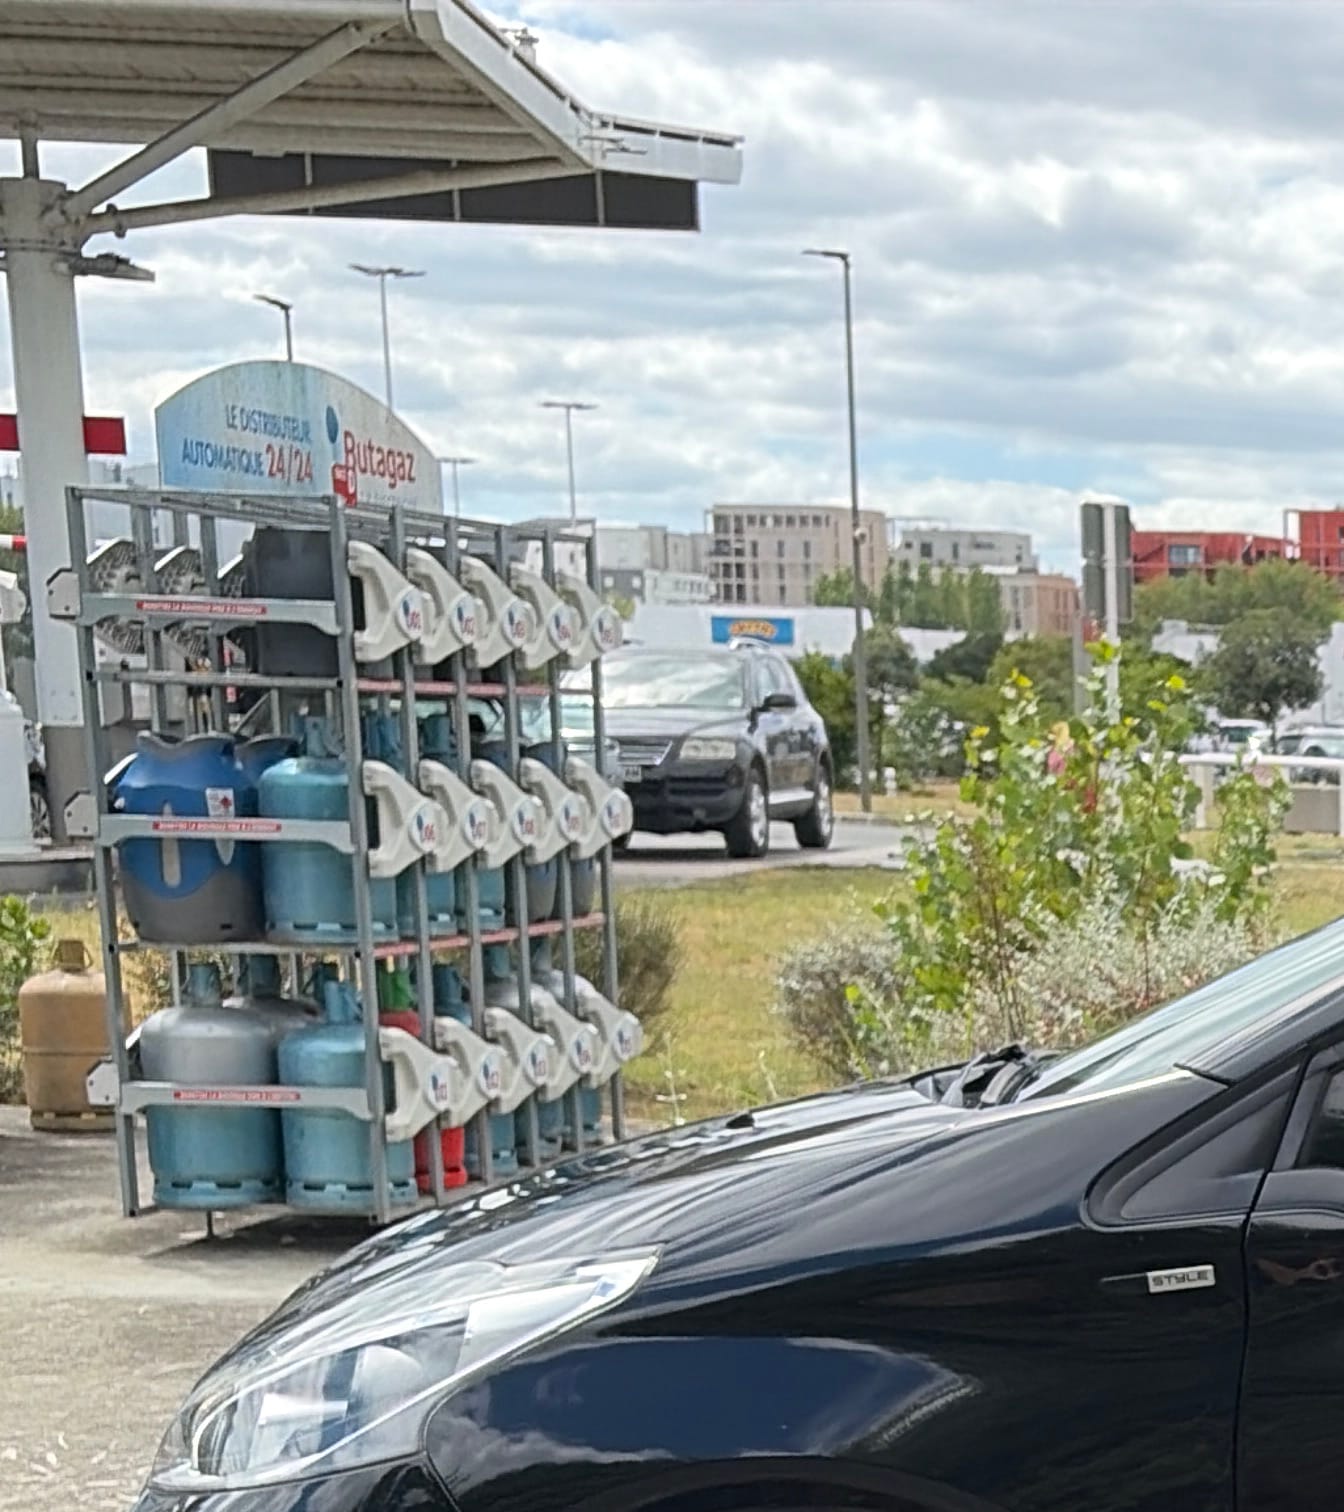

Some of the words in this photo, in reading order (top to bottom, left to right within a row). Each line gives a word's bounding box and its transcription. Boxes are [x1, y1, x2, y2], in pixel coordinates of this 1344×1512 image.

[225, 403, 238, 430] LE
[240, 406, 312, 443] DISTRIBUTEUR
[182, 437, 264, 476] AUTOMATIQUE
[265, 442, 313, 486] 24/24
[343, 430, 416, 490] Butagaz
[1151, 1269, 1210, 1287] STYLE
